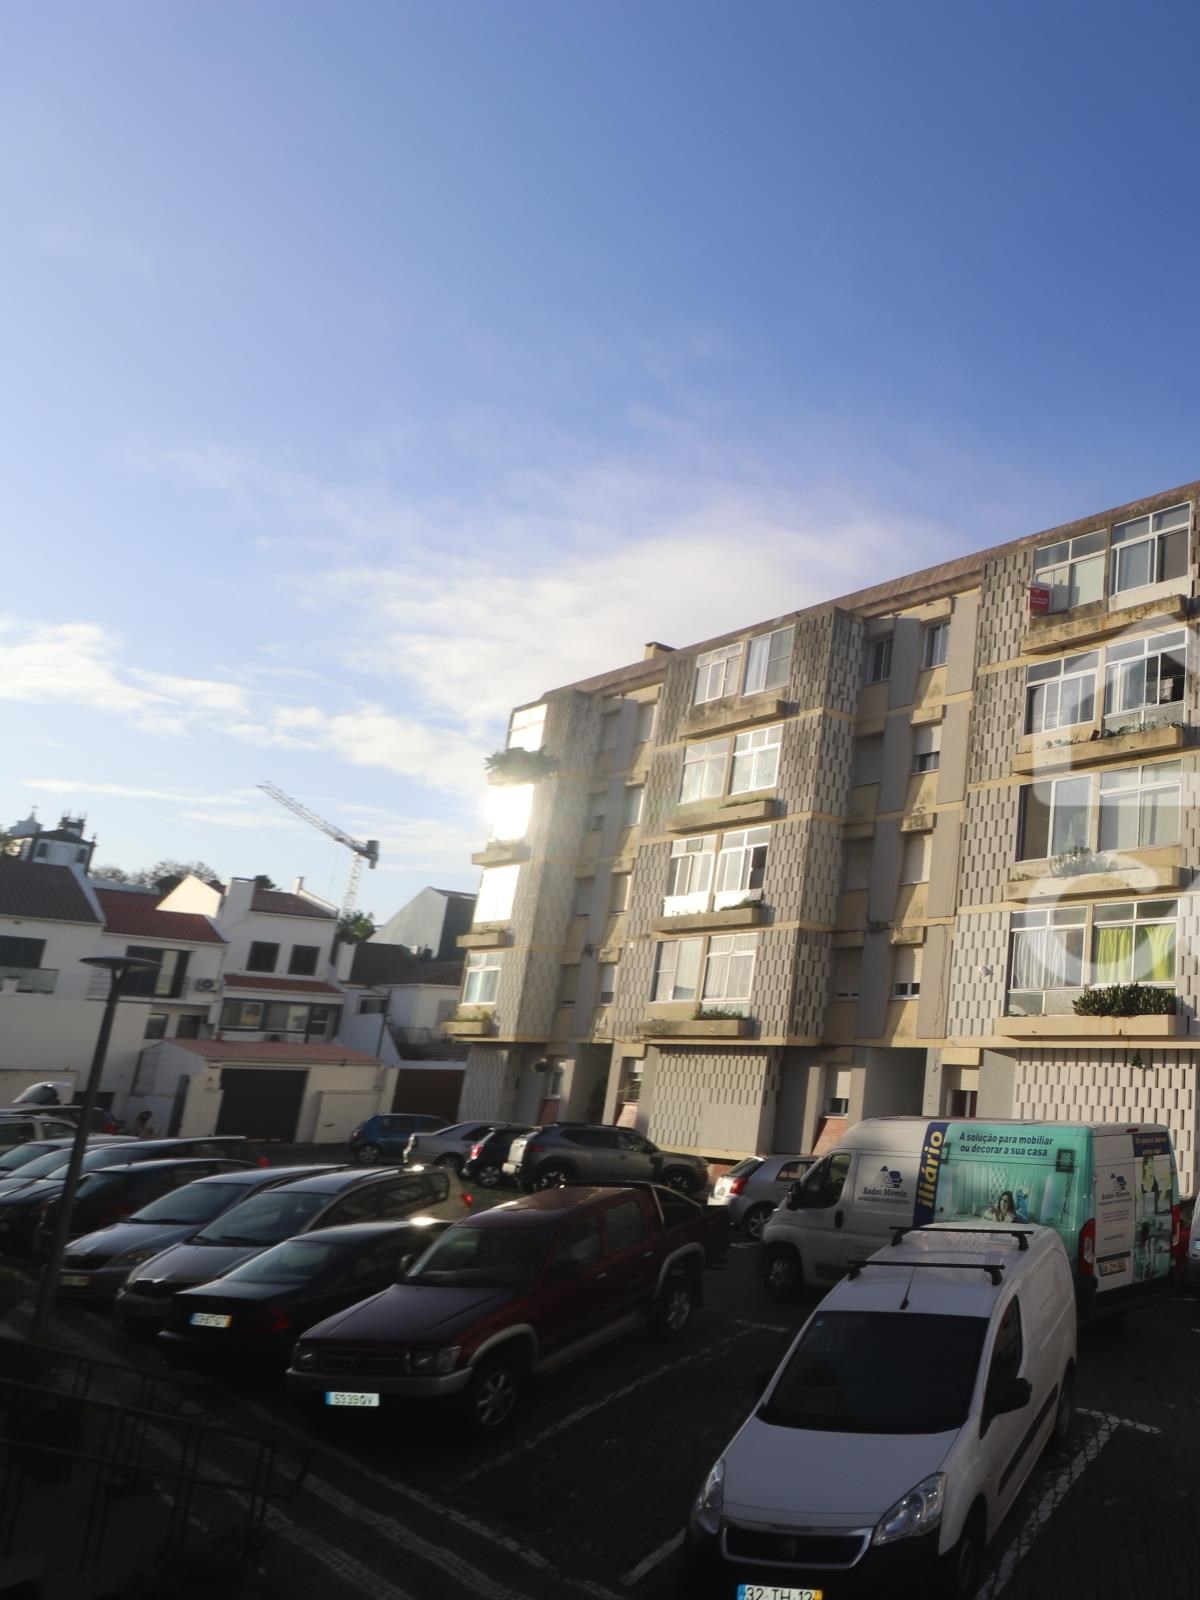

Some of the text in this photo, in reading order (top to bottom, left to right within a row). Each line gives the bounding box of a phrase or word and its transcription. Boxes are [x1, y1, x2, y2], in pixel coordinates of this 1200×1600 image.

[959, 1132, 1054, 1146] A solução para mobiliar
[971, 1145, 1002, 1155] decorar
[1011, 1148, 1026, 1156] sua
[1027, 1149, 1048, 1157] casa
